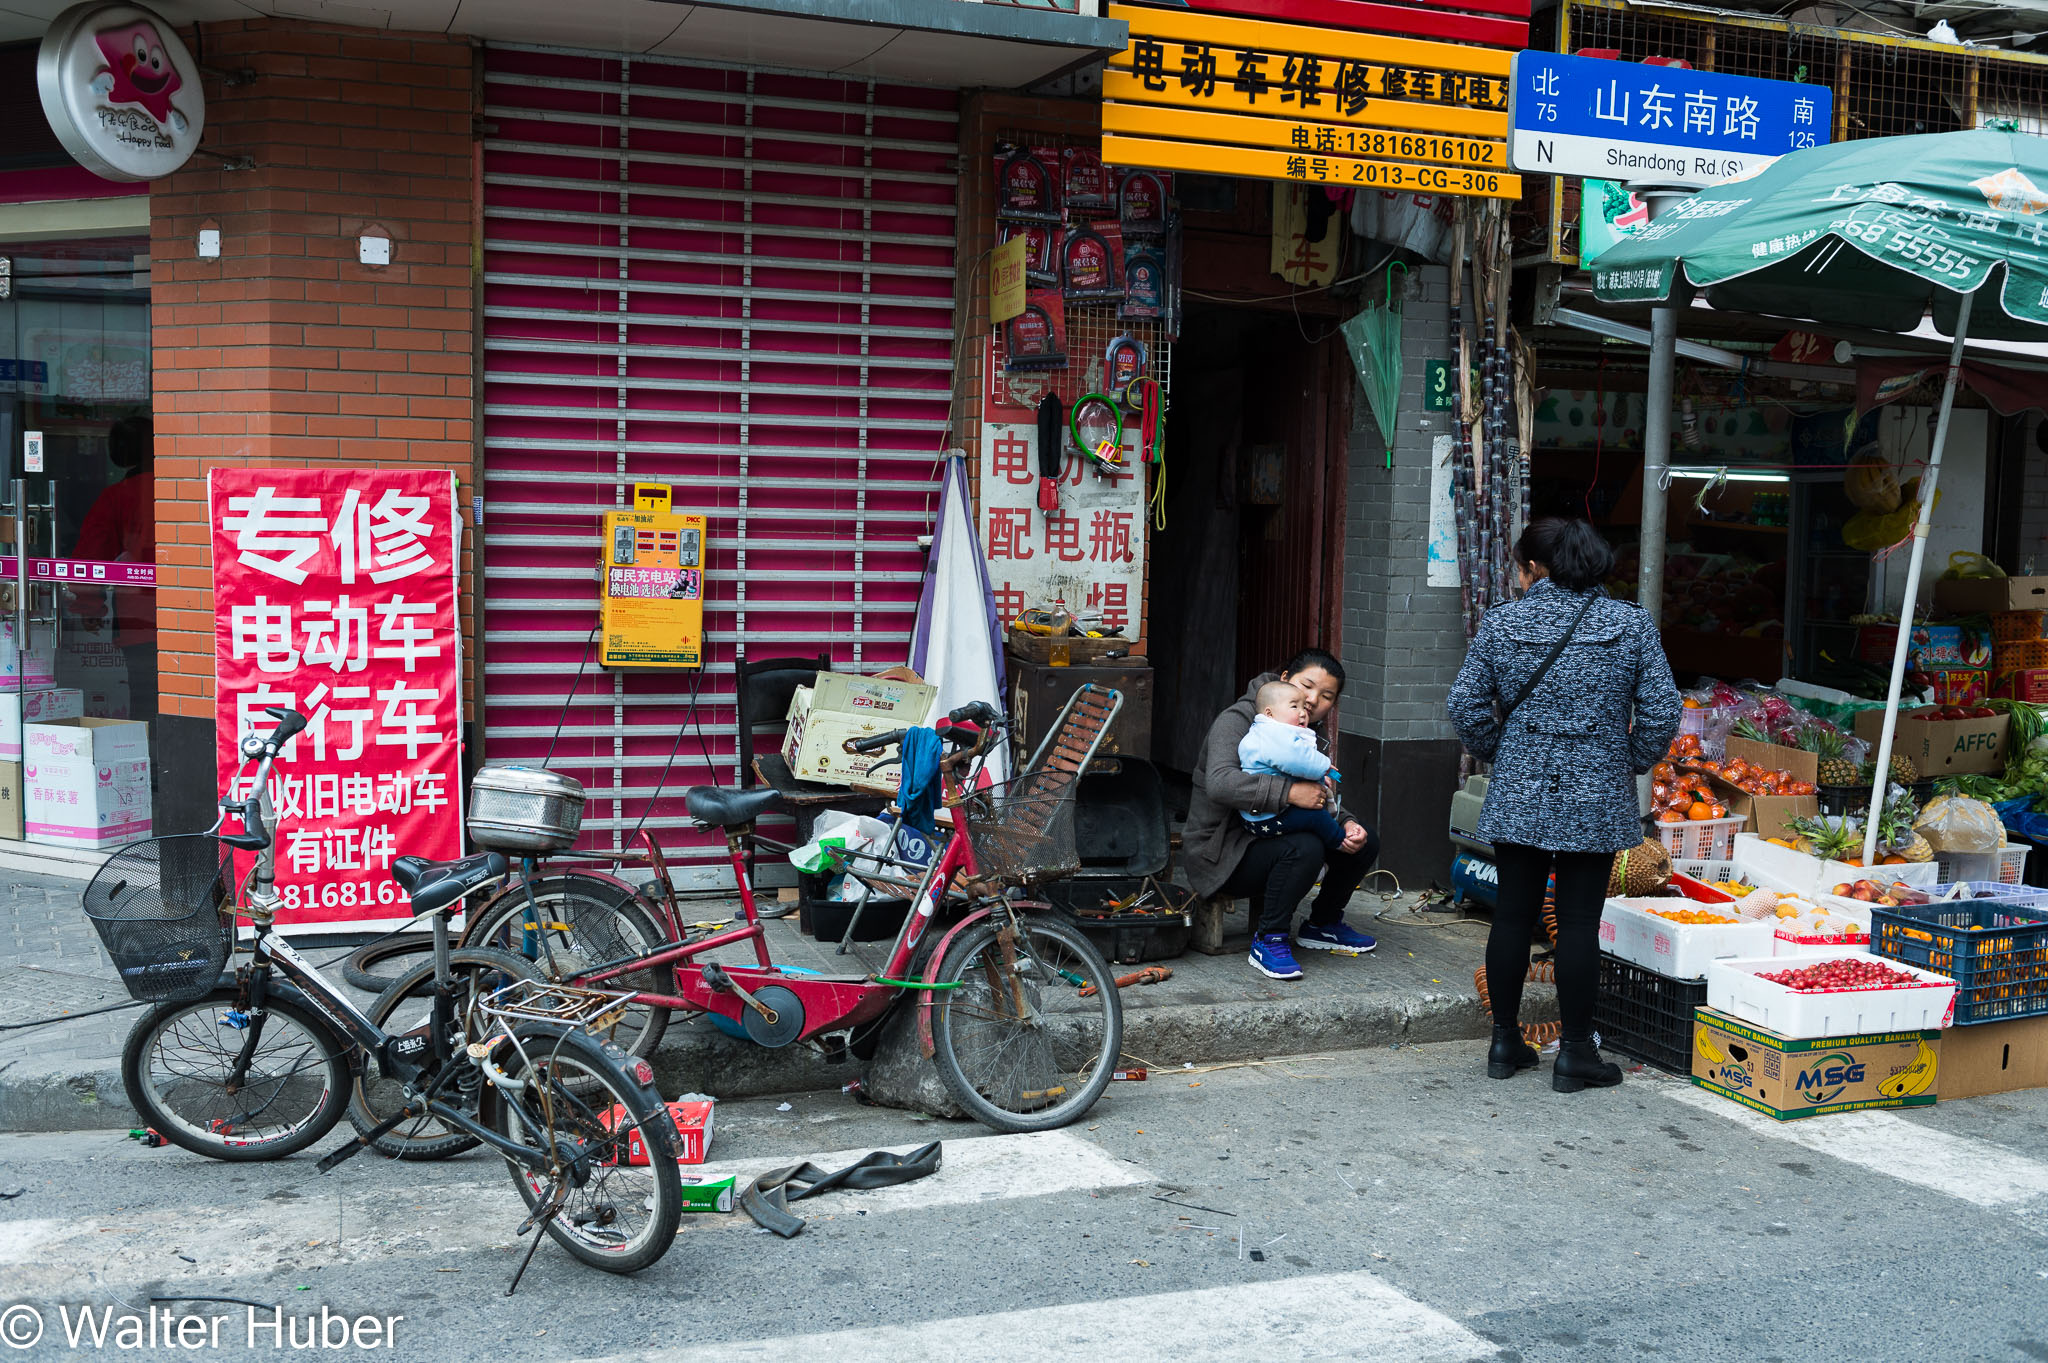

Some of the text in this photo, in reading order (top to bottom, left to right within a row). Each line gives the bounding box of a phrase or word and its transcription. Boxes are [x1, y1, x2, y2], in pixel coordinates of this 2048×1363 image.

[1132, 34, 1371, 117] 电动车维修
[1532, 67, 1560, 97] 北
[1536, 102, 1558, 123] 75
[1595, 79, 1761, 141] 山东南路
[1793, 96, 1815, 127] 南
[1537, 140, 1554, 164] N
[1788, 130, 1816, 149] 125
[1606, 148, 1686, 176] Shandong
[1352, 163, 1499, 193] 2013-CG-306
[1884, 231, 1979, 280] 55555
[222, 486, 436, 586] 专修
[987, 506, 1135, 564] 配电瓶
[610, 568, 677, 585] 便民充电站
[231, 593, 441, 673] 电动车
[236, 680, 443, 764] 自行车
[1954, 732, 1997, 753] AFFC
[33, 787, 79, 805] 香酥紫薯
[286, 824, 397, 874] 有证件
[1696, 1012, 1724, 1028] PREMIUM
[1725, 1022, 1751, 1038] QUALITY
[1752, 1032, 1783, 1049] BANANAS
[1811, 1032, 1921, 1049] PREMIUM QUALITY BANANAS
[1720, 1066, 1753, 1088] MSG
[1795, 1063, 1866, 1091] MSG
[1700, 1080, 1776, 1116] PRODUCT OF THE PHILIPPINES
[1816, 1099, 1903, 1114] PRODUCT OF THE PHILIPPINES
